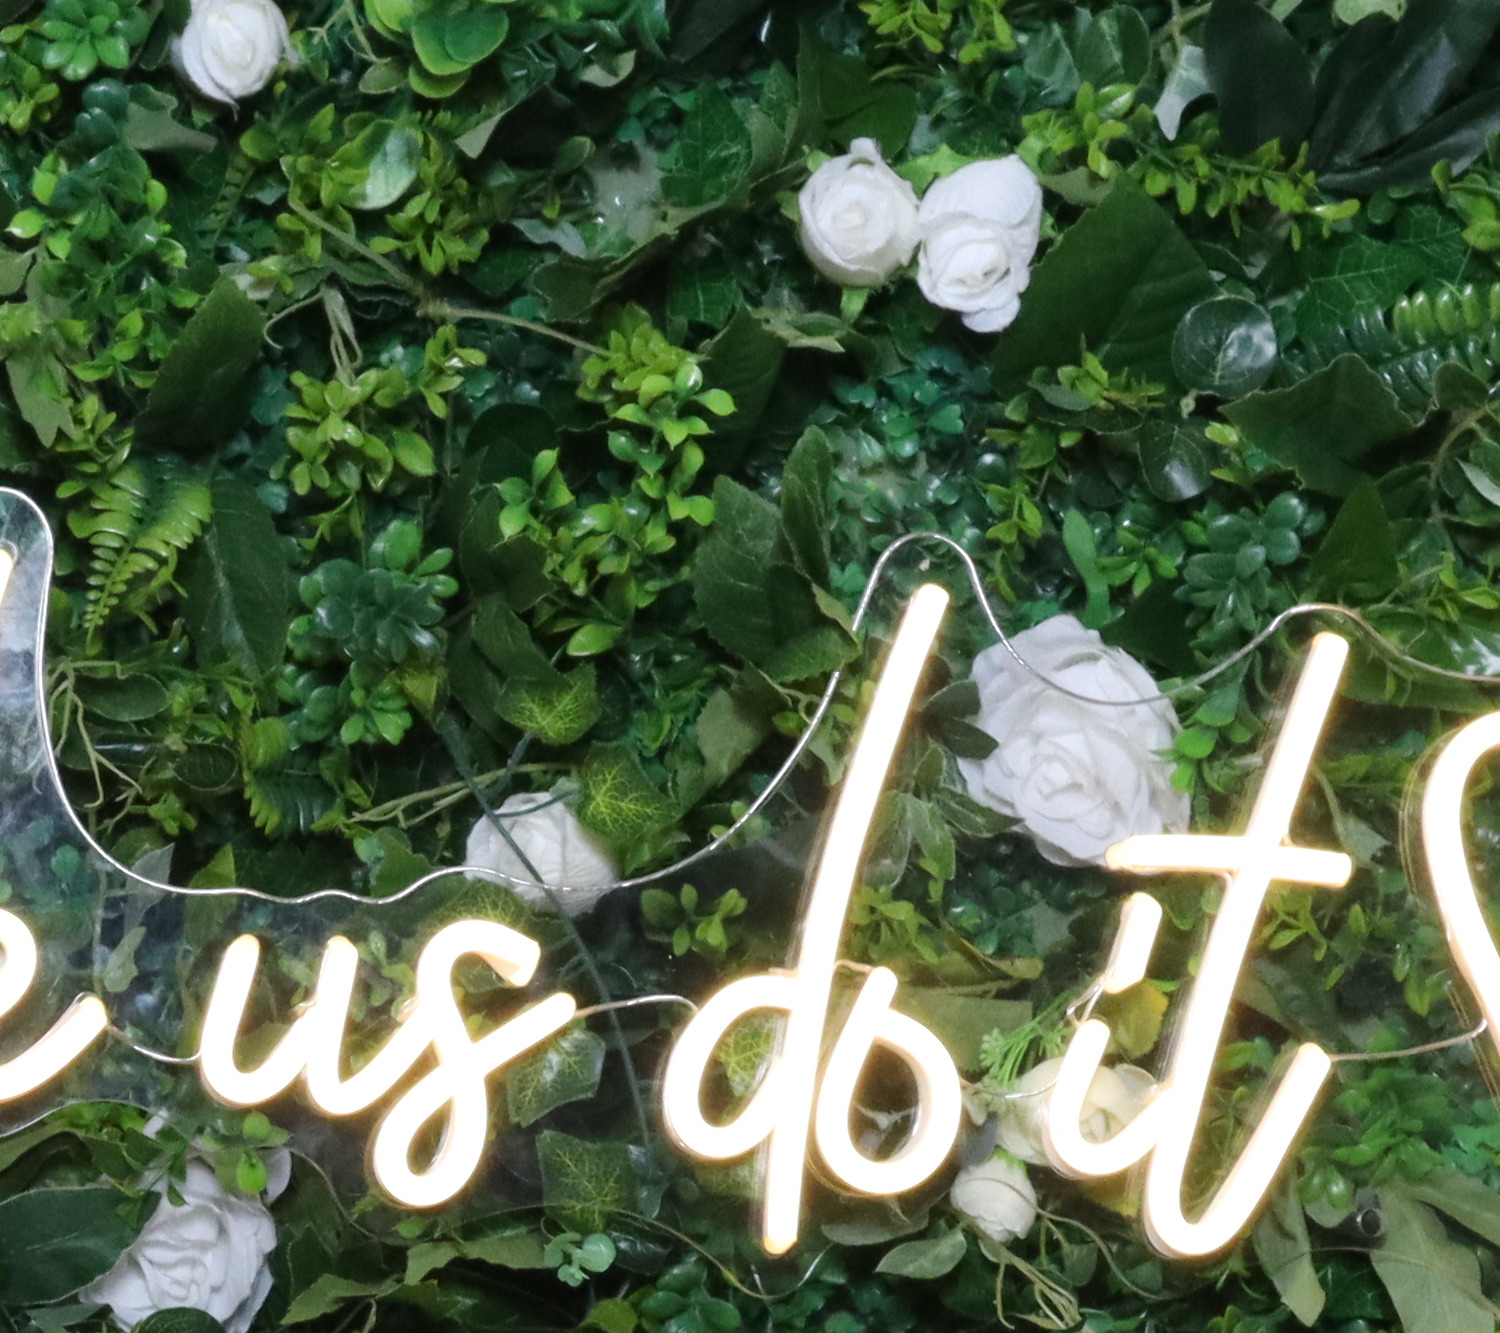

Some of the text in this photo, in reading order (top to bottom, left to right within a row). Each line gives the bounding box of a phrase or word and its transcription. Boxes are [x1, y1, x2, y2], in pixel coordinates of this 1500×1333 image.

[198, 918, 577, 1211] us
[661, 583, 963, 1257] do
[1043, 633, 1353, 1262] it
